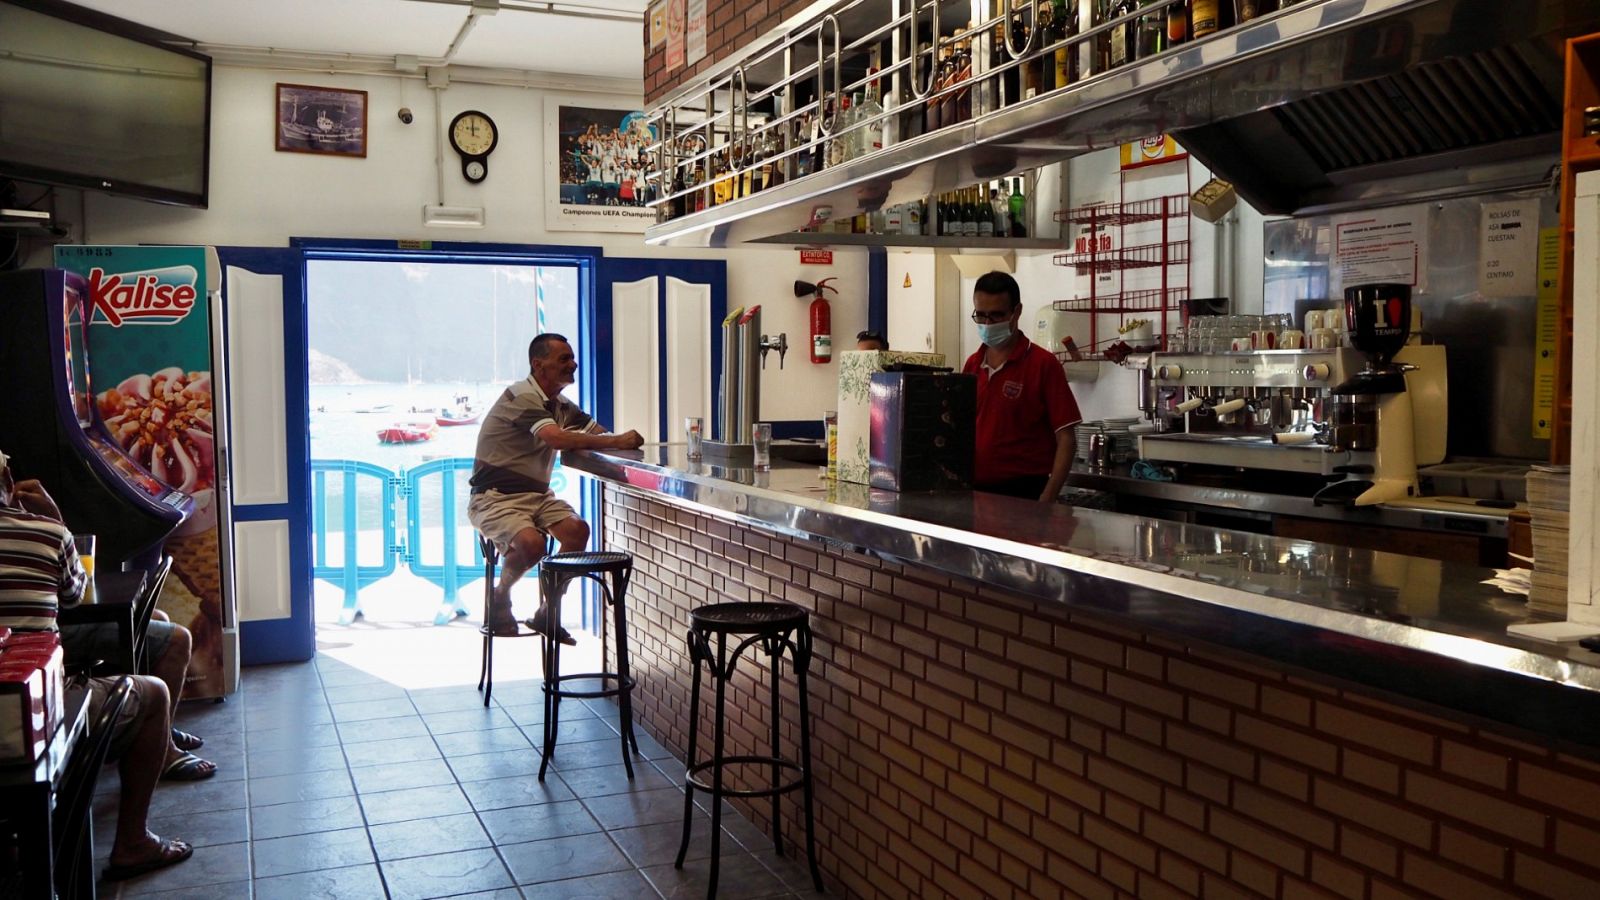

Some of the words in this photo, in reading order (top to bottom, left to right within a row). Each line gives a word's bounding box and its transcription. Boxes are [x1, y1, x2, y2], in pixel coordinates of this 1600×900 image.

[563, 208, 601, 216] Campeones
[1489, 210, 1511, 219] BOLSAS
[1512, 209, 1521, 217] DE
[1075, 236, 1086, 254] NO
[88, 268, 196, 326] Kalise
[1373, 299, 1388, 328] I
